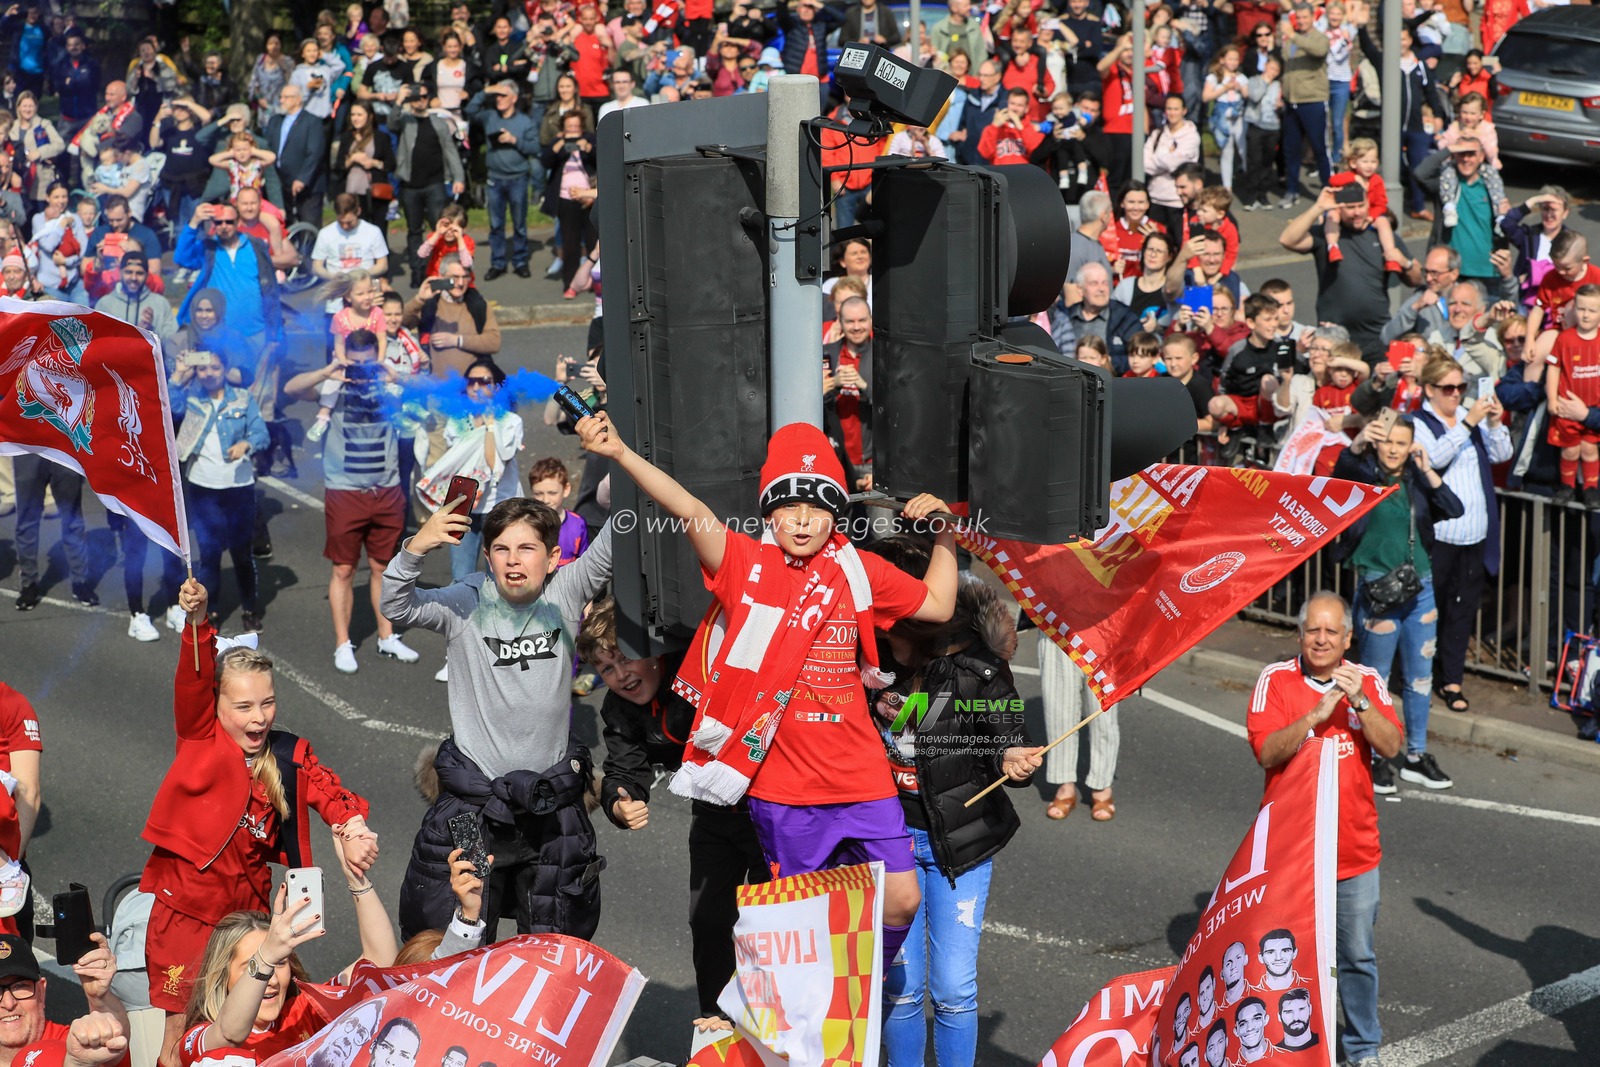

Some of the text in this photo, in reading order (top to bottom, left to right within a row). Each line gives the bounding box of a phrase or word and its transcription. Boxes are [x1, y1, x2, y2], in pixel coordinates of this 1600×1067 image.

[876, 60, 896, 81] AGD
[892, 76, 906, 89] 220
[499, 636, 551, 660] DSQ2
